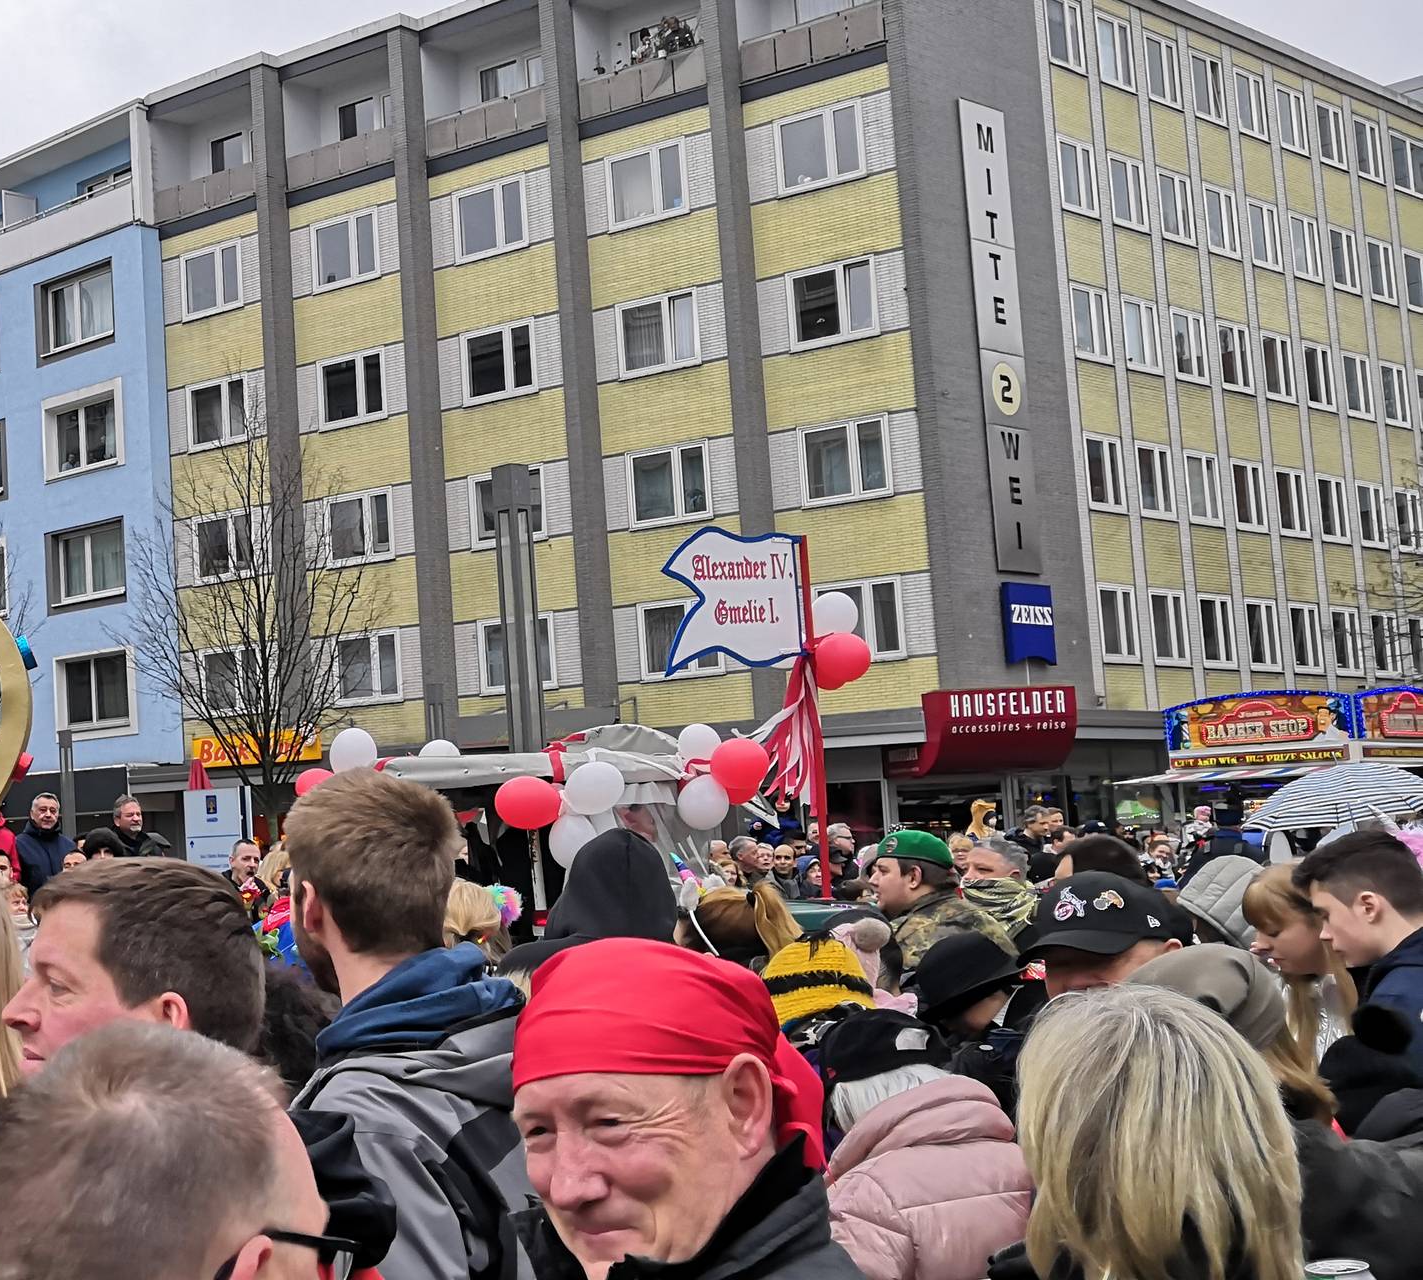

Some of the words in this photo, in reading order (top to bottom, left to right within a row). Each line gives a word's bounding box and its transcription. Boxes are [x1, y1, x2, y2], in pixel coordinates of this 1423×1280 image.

[976, 123, 1007, 325] MITTE
[692, 554, 767, 581] Alexander
[769, 553, 793, 579] IV.
[1010, 603, 1053, 626] ZEISS
[950, 690, 1066, 717] HAUSFELDER
[951, 722, 1020, 734] accessoires
[1036, 719, 1067, 730] reise
[1206, 721, 1265, 740] BARBER
[1269, 718, 1309, 737] SHOP
